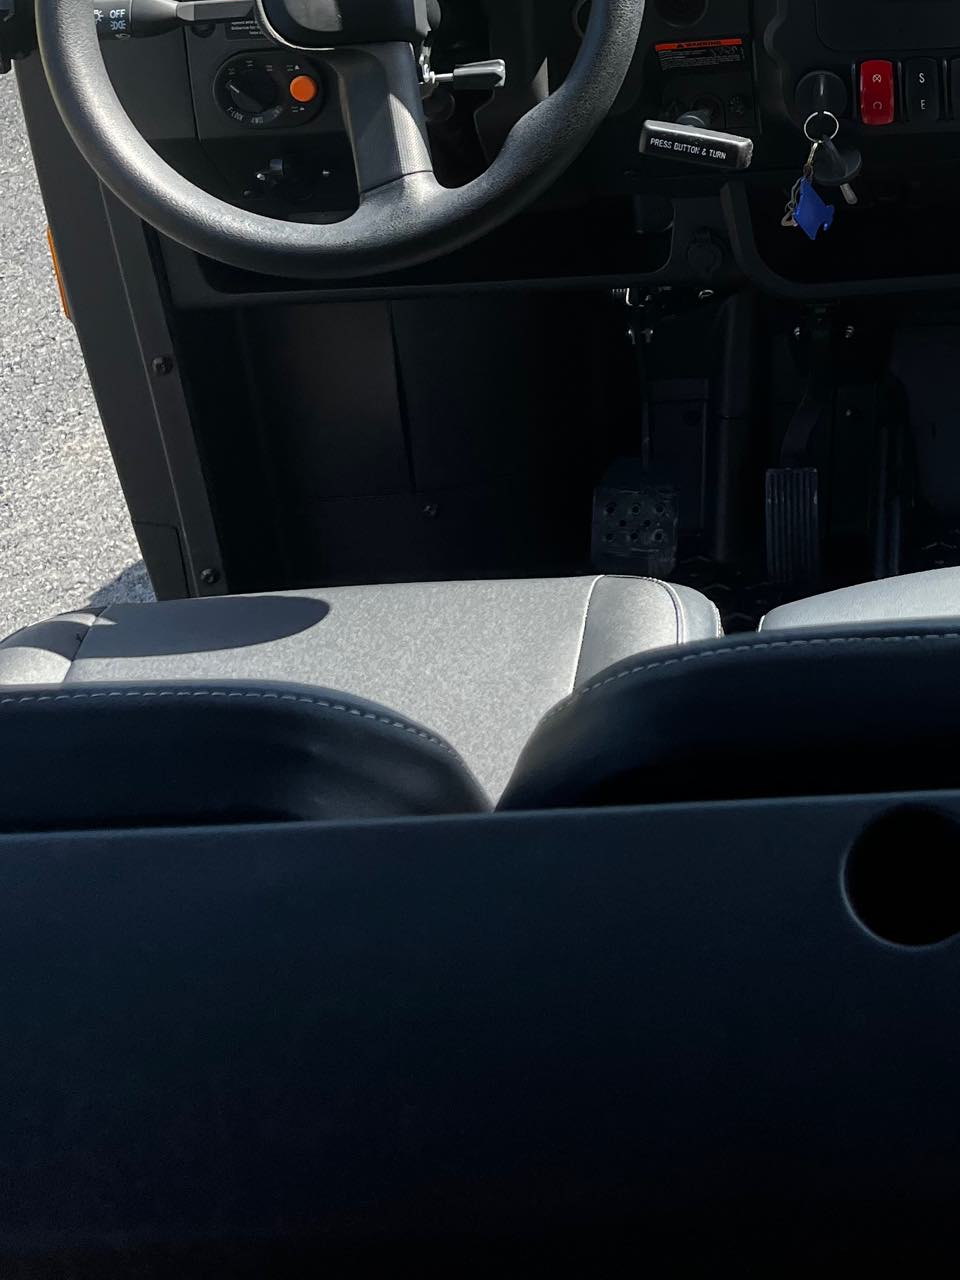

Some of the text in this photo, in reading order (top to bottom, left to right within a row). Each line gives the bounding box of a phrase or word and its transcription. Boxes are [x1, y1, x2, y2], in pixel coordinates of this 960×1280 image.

[110, 9, 126, 19] OFF
[919, 72, 925, 84] S
[920, 99, 926, 110] E
[650, 138, 727, 160] PRESS BUTTON & TURN
